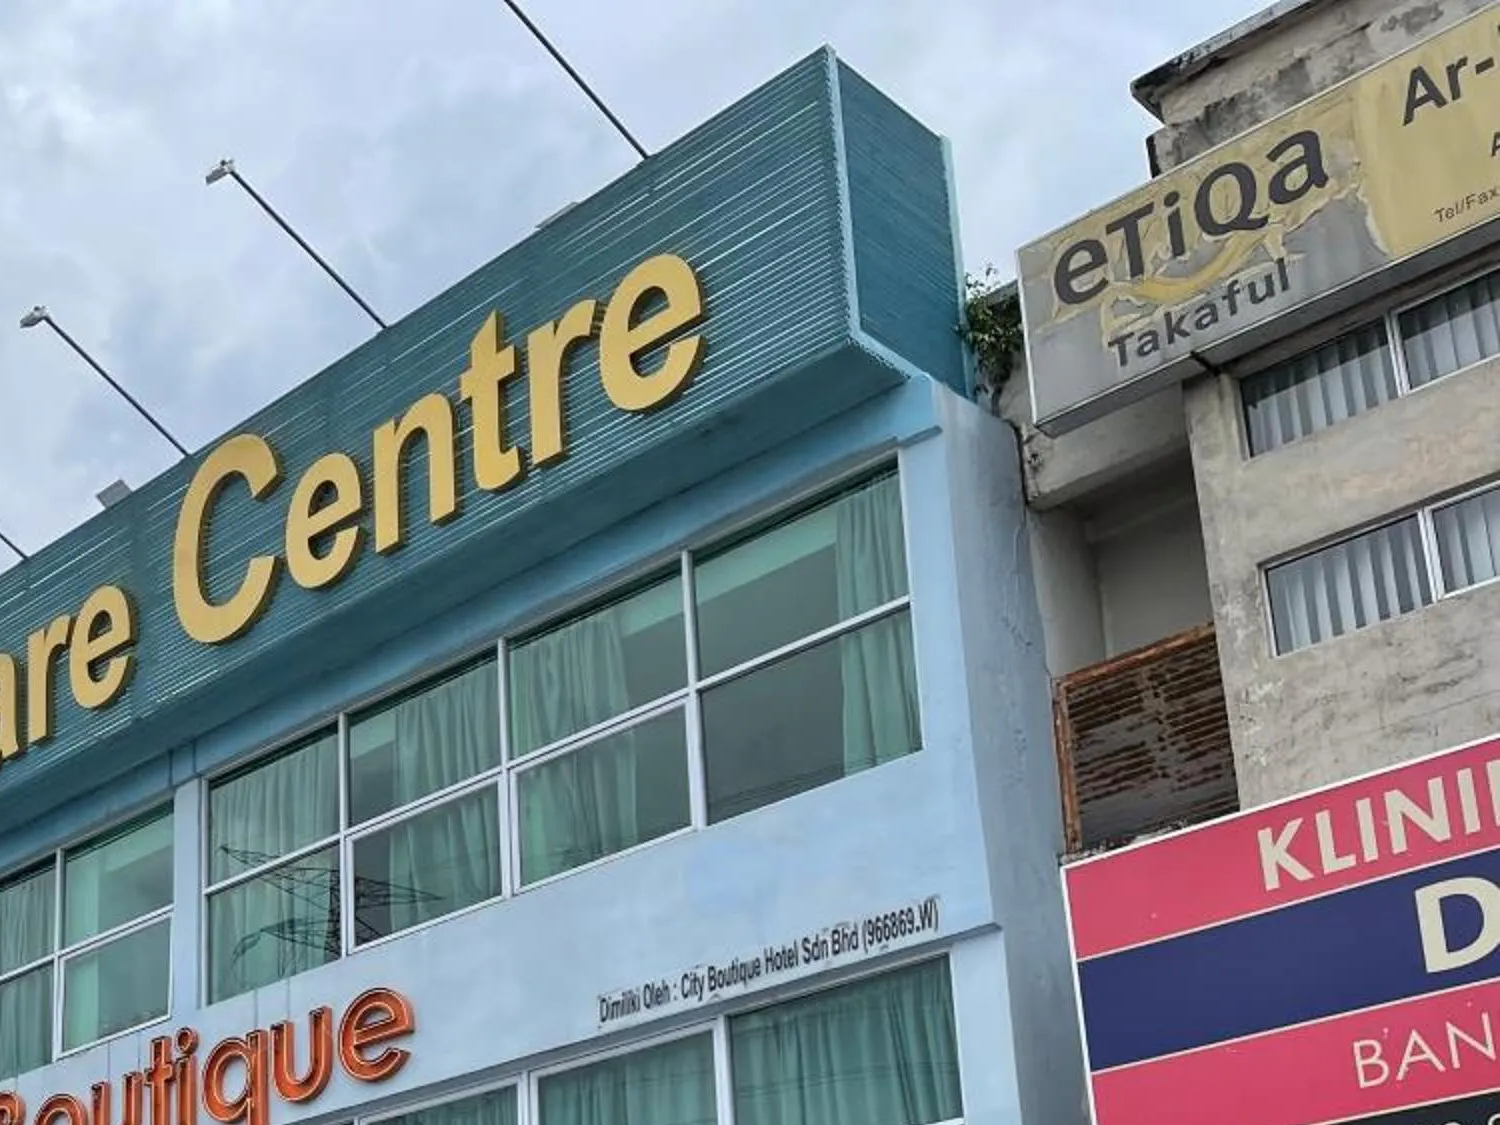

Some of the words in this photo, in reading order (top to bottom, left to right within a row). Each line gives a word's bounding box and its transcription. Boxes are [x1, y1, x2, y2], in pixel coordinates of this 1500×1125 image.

[1108, 257, 1290, 369] Takaful
[173, 253, 706, 644] Centre
[599, 984, 642, 1023] Dimiliki
[643, 978, 671, 1010] Oleh
[680, 969, 705, 1002] City
[707, 957, 761, 992] Boutique
[764, 938, 799, 974] Hotel
[801, 933, 829, 965] Sdn
[831, 922, 859, 956] Bhd
[1353, 1012, 1497, 1089] BAN
